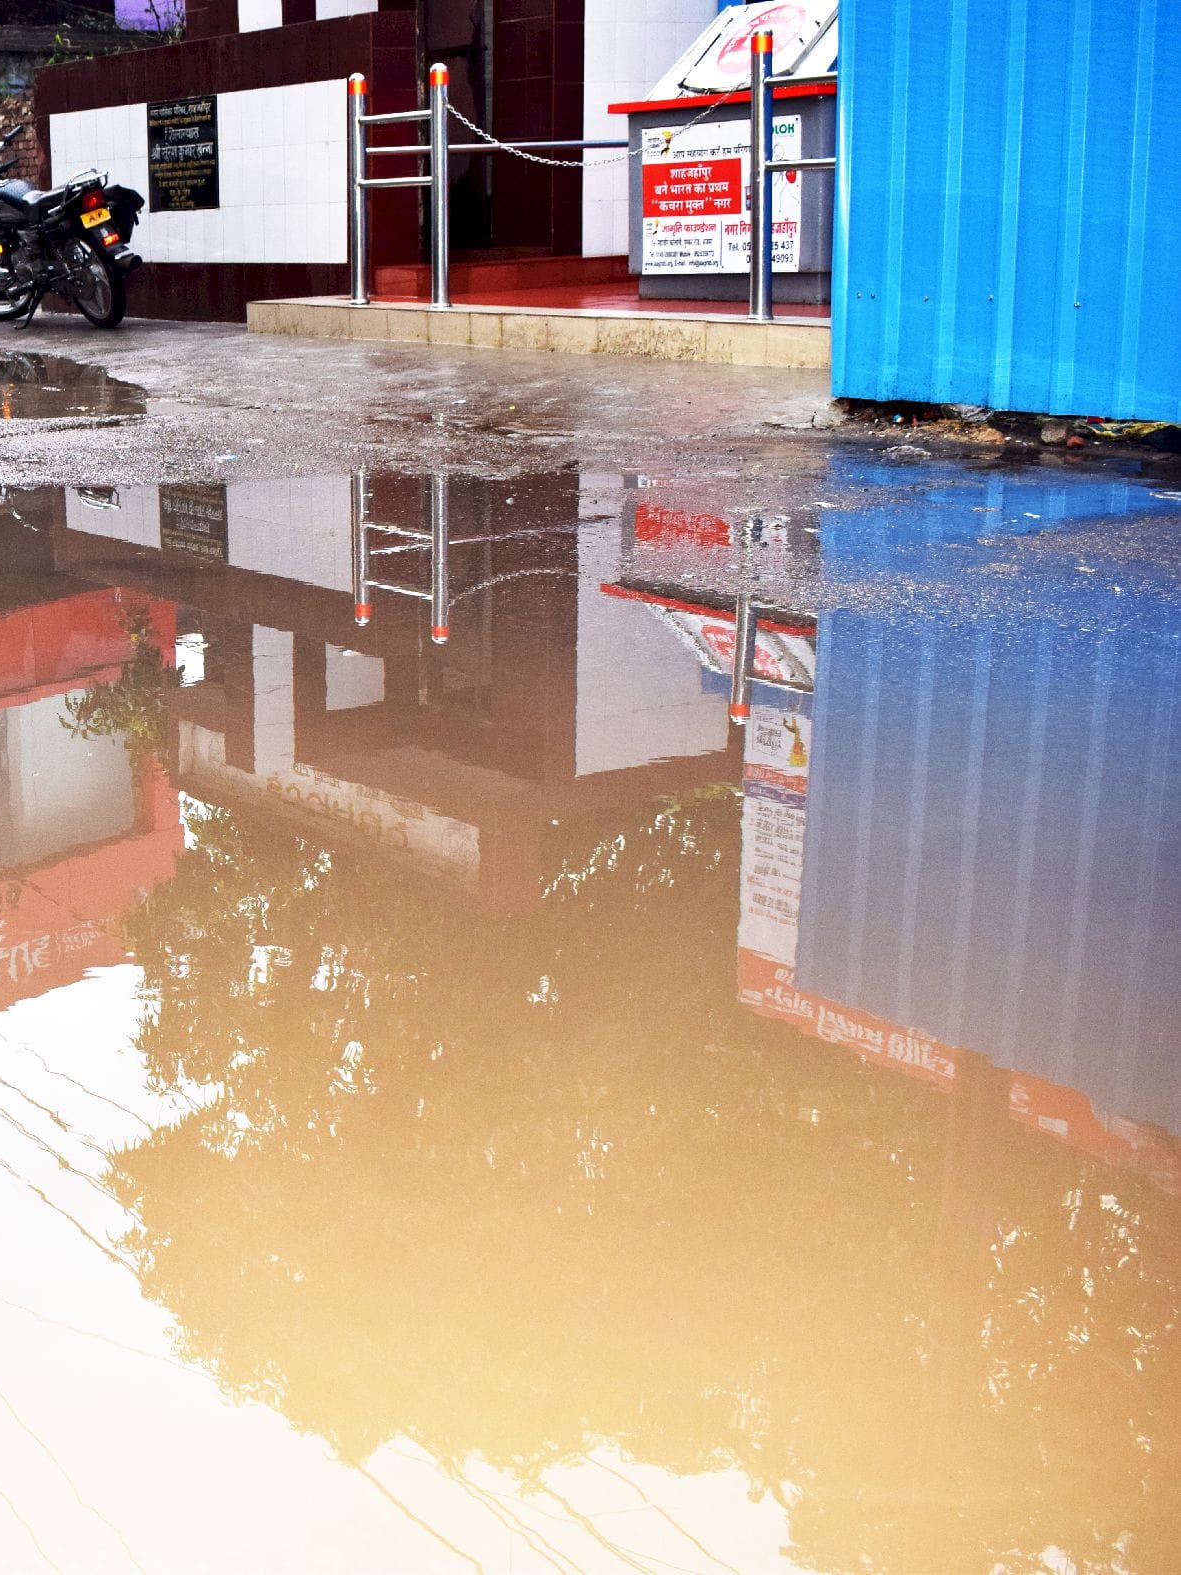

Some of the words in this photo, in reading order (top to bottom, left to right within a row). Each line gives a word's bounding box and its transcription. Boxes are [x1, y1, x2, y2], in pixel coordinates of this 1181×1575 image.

[670, 164, 713, 181] शाहजहाँपुर
[654, 182, 668, 195] बने
[670, 184, 691, 195] भारत
[694, 183, 706, 194] का
[708, 181, 729, 193] प्रथम
[713, 198, 731, 209] नगर
[724, 223, 739, 235] नगर
